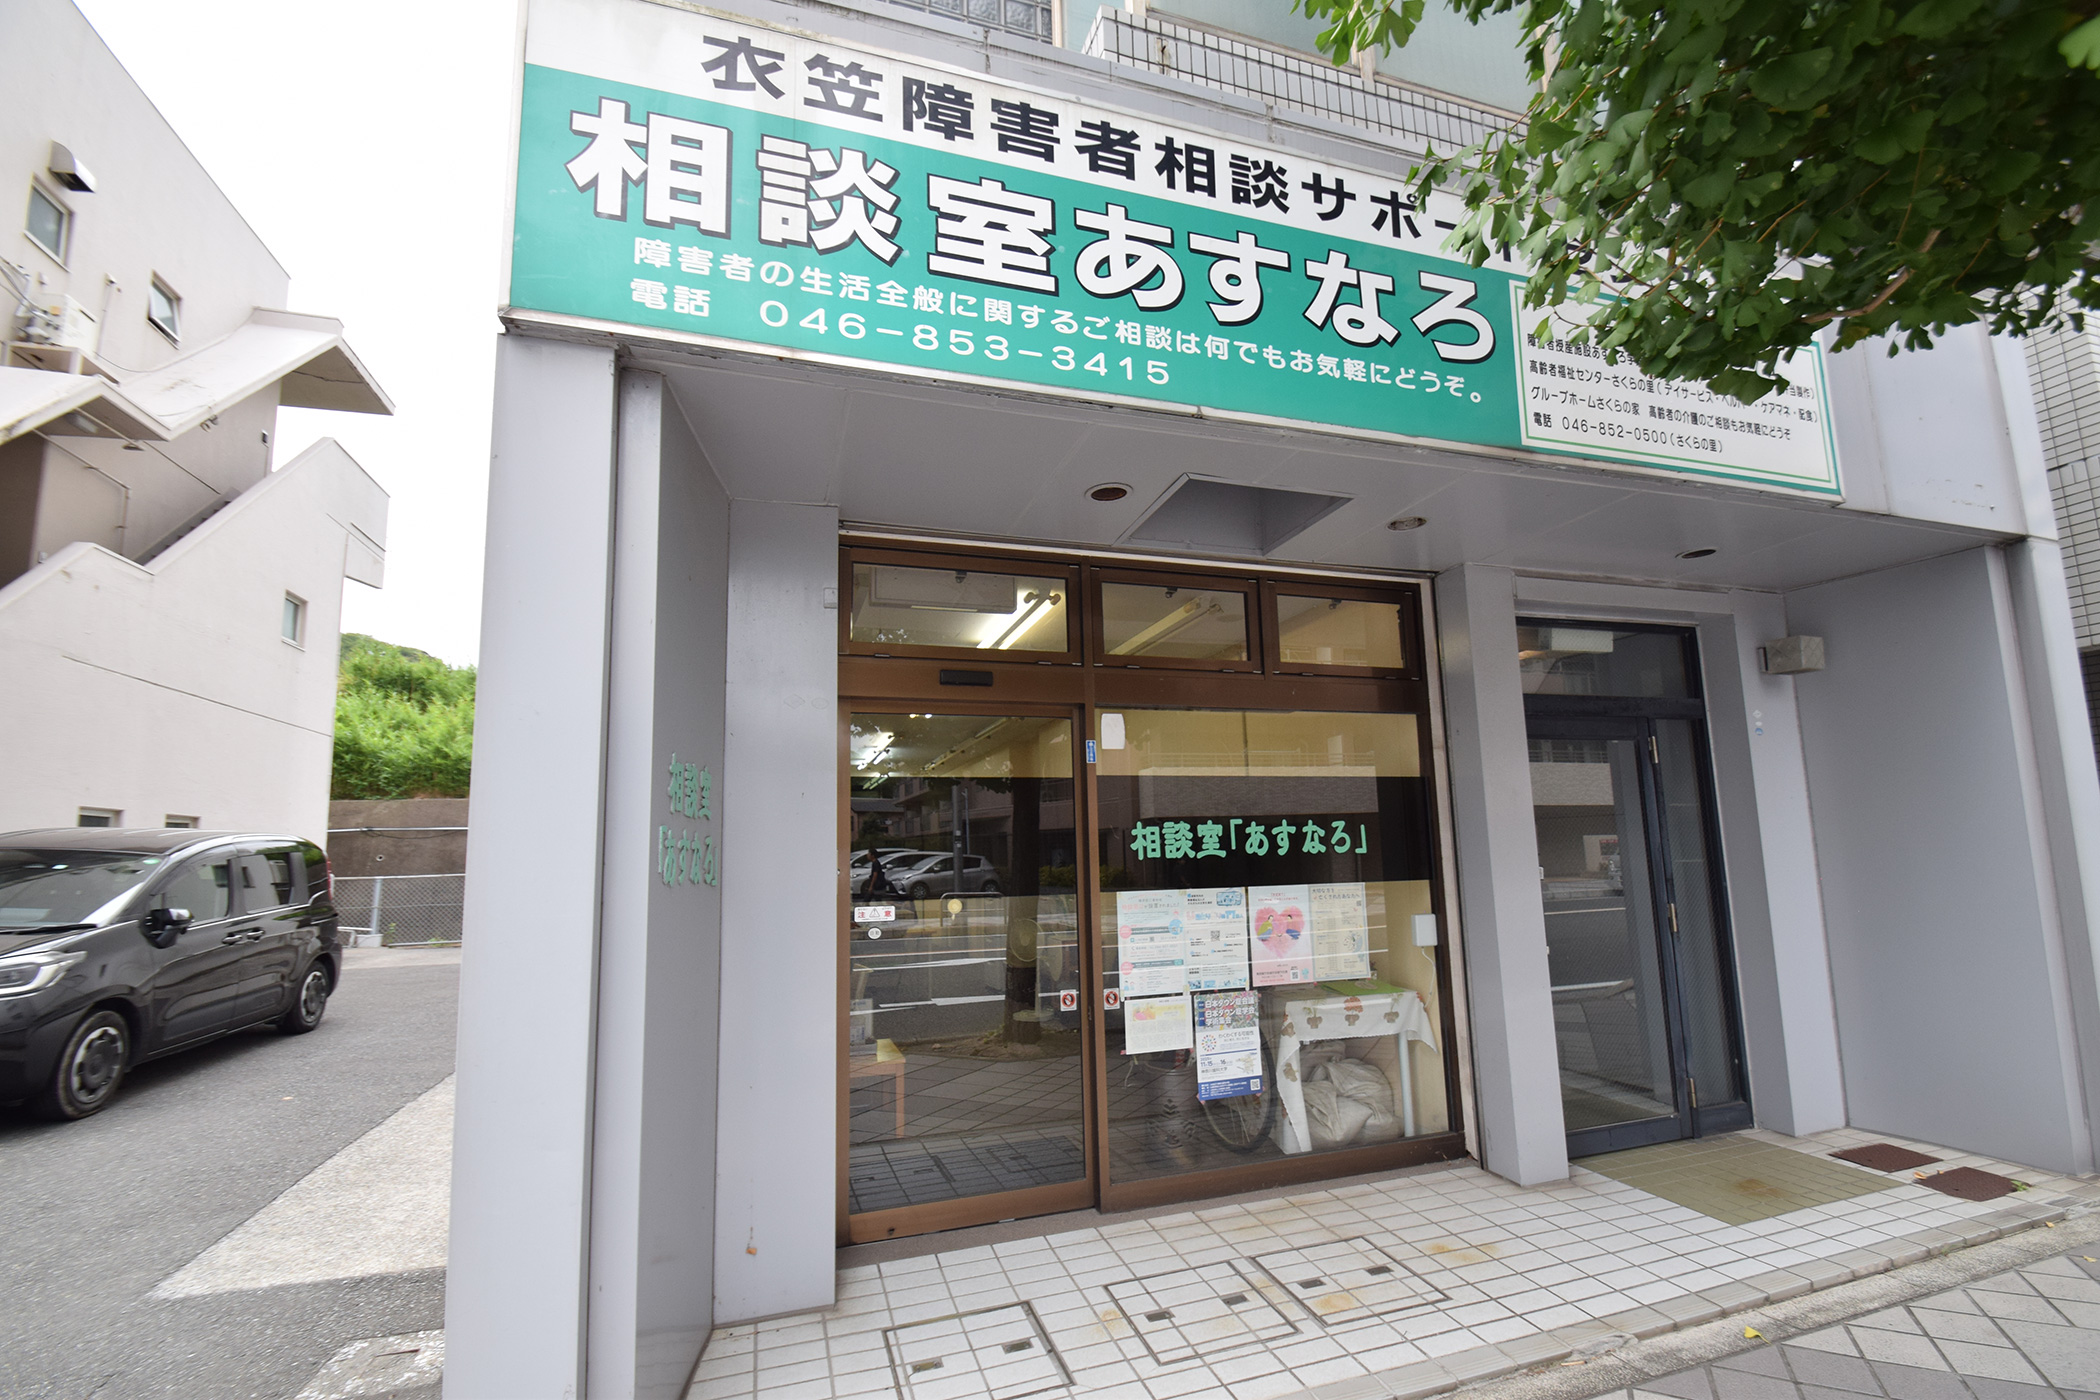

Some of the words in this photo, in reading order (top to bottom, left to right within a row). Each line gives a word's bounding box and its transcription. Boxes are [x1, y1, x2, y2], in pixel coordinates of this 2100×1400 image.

[701, 35, 1640, 284] 衣笠障害者相談サポー
[564, 95, 1497, 364] 相談室あすなろ
[629, 277, 710, 318] 電話
[634, 236, 1482, 404] 障害者の生活全般に関するご相談は何でもお気軽にどうぞ。
[1531, 386, 1641, 416] グループホームさくらの家
[1533, 411, 1552, 428] 電話
[667, 751, 713, 821] 相談室
[1129, 818, 1368, 861] 相談室「あすなろ」
